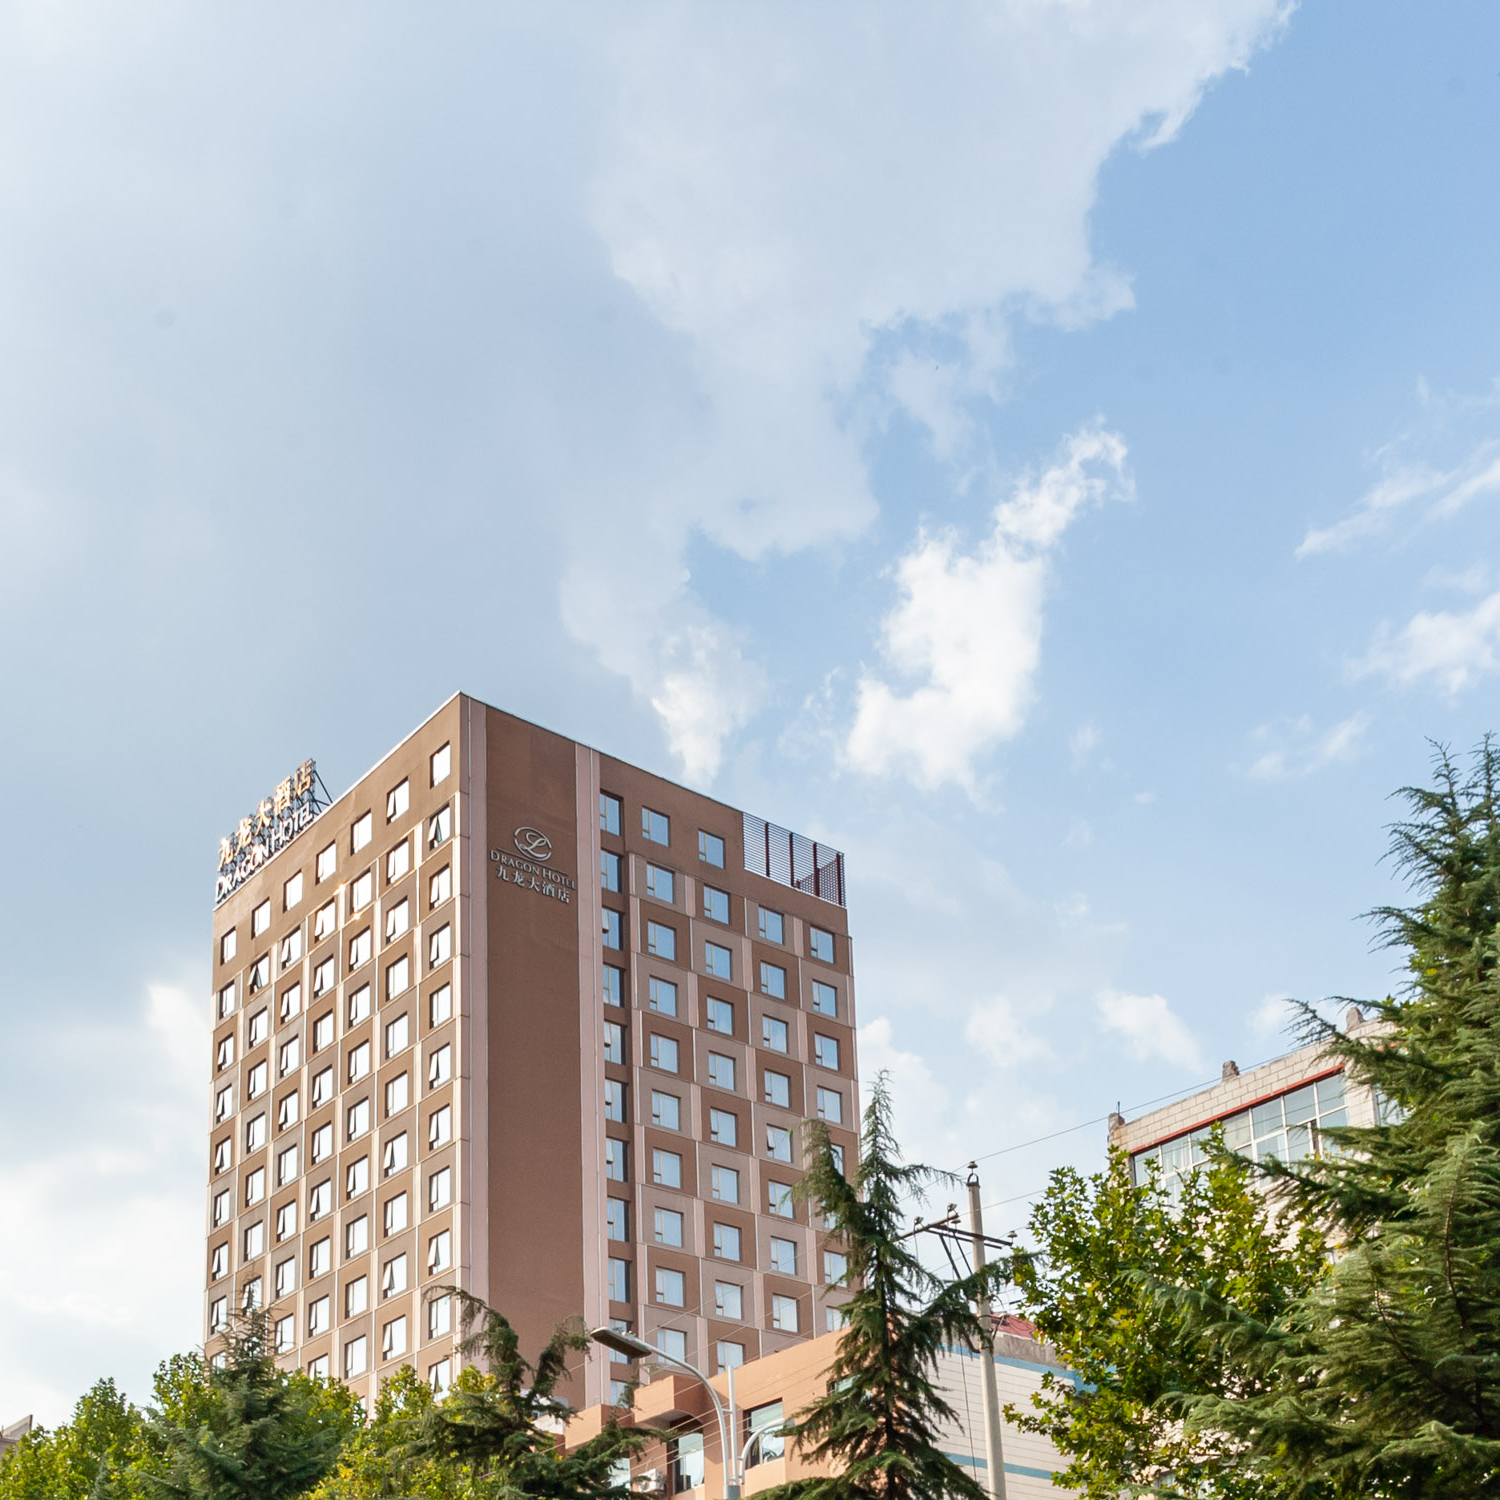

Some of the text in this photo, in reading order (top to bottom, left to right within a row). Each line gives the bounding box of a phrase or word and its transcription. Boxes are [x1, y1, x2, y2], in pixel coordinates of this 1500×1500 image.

[217, 757, 313, 872] 九龙大酒店
[215, 801, 314, 903] DRAGON HOTEL
[490, 849, 577, 890] DRAGON HOTEL
[496, 864, 571, 904] 九龙大酒店
